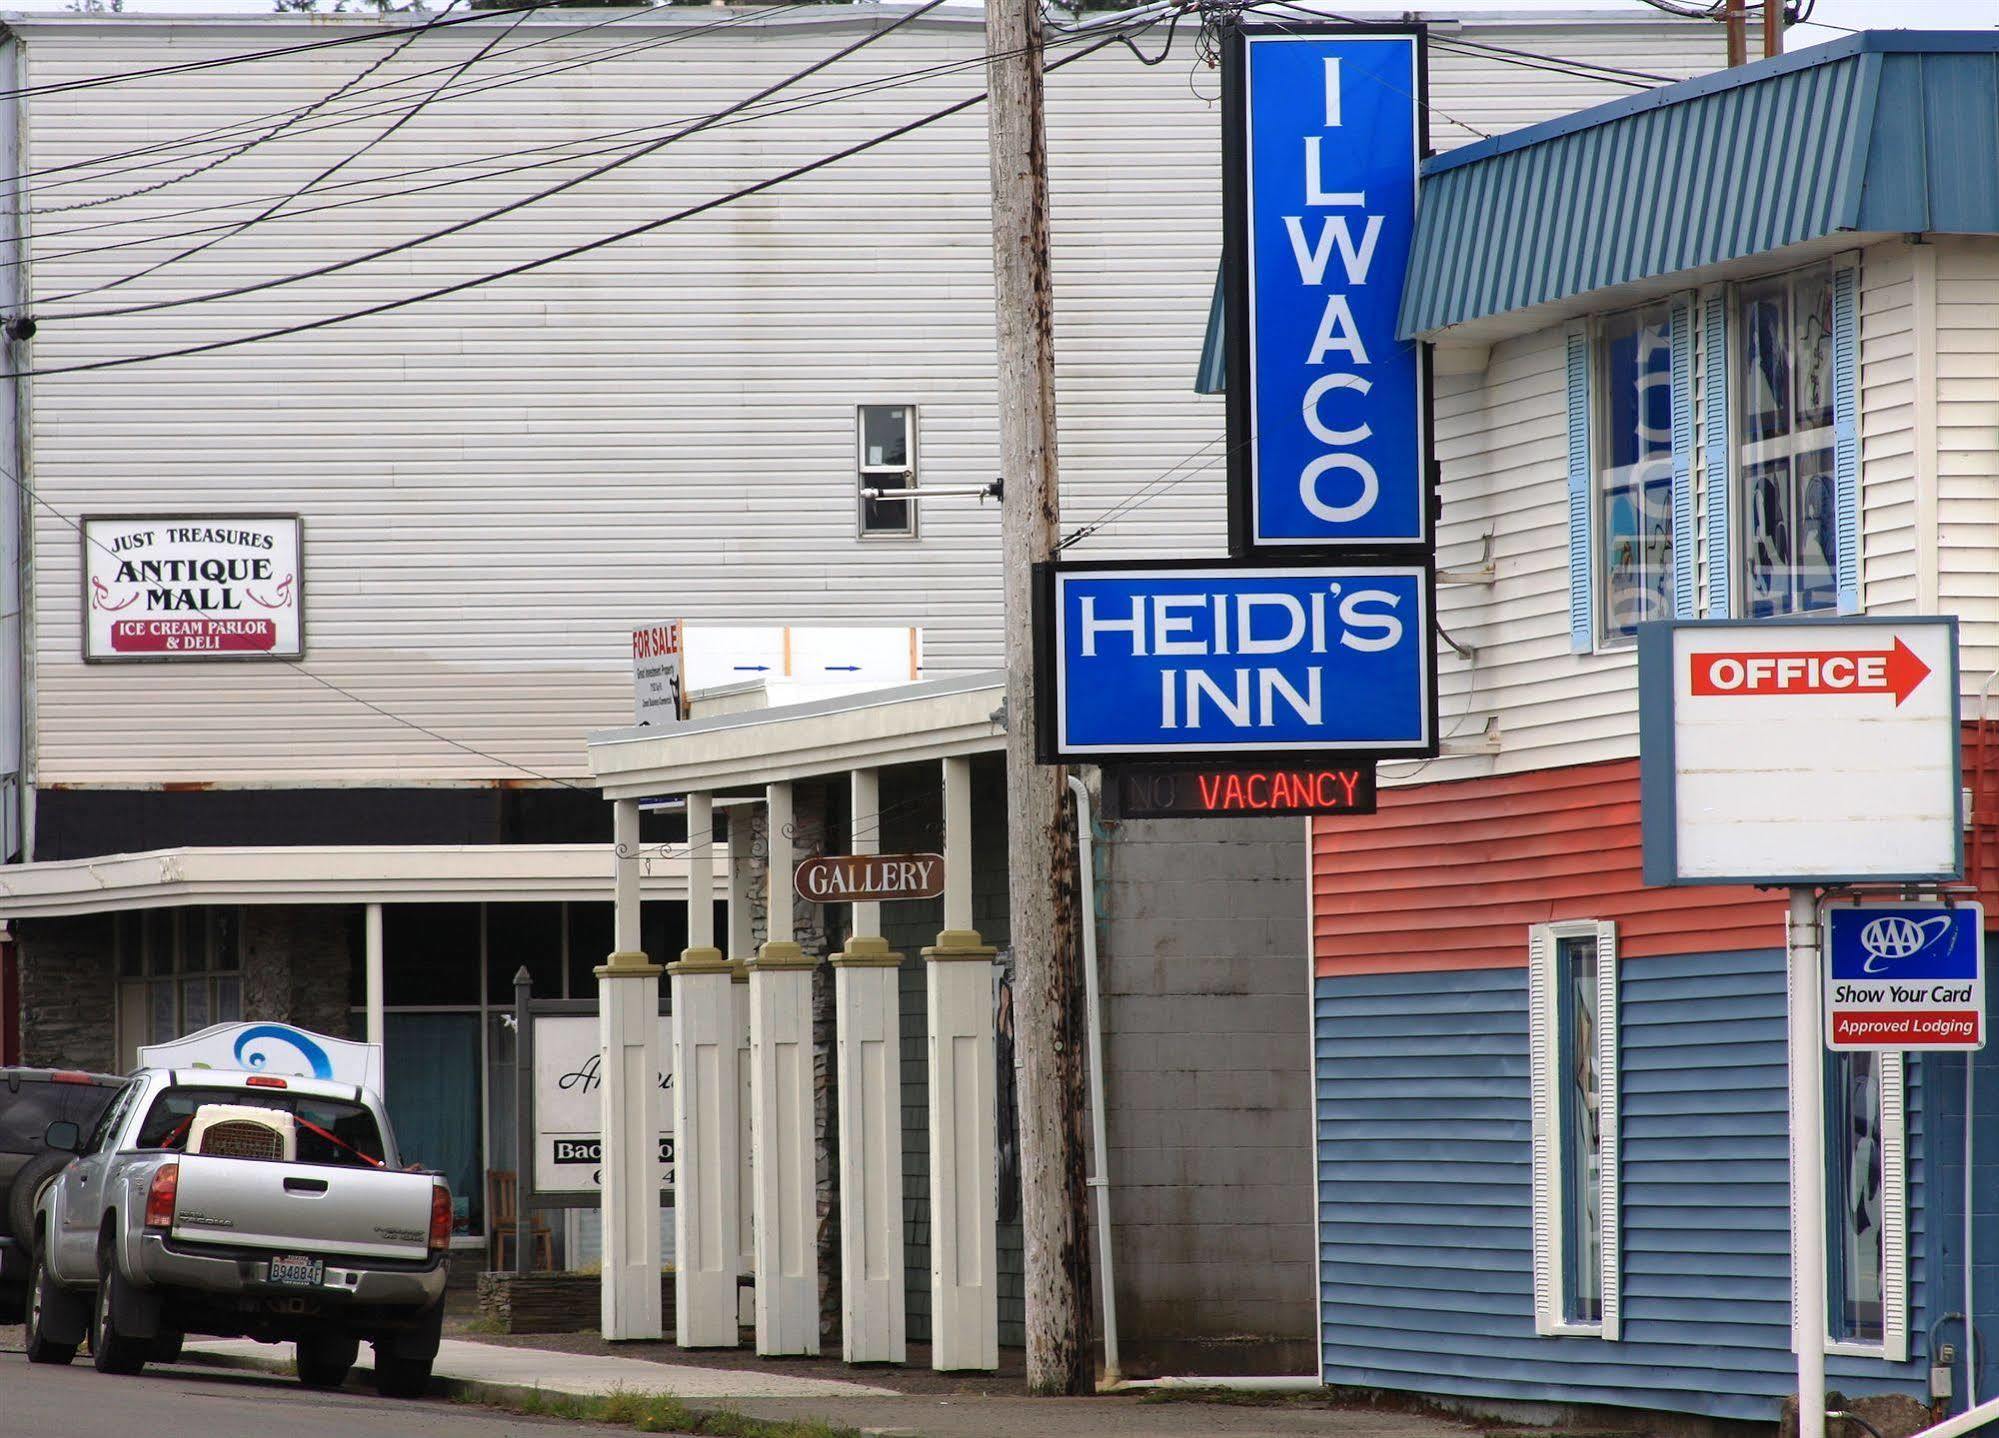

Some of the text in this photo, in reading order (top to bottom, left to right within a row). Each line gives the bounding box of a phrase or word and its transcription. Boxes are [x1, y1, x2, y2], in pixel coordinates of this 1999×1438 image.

[1281, 57, 1387, 523] ILWACO
[111, 528, 274, 553] JUST TREASURES
[114, 558, 273, 584] ANTIQUE
[146, 588, 242, 611] MALL
[119, 621, 267, 636] ICE CREAM PARLOR
[1078, 582, 1403, 657] HEIDI'S
[166, 636, 220, 649] & DELI
[633, 625, 678, 659] FOR SALE
[1709, 657, 1888, 690] OFFICE
[1160, 666, 1325, 729] INN
[1199, 771, 1360, 811] VACANCY
[808, 860, 936, 895] GALLERY
[1869, 918, 1918, 957] AAA
[1835, 985, 1973, 1003] Show Your Card
[1838, 1019, 1974, 1035] Approved Lodging
[273, 1264, 321, 1282] B94884F
